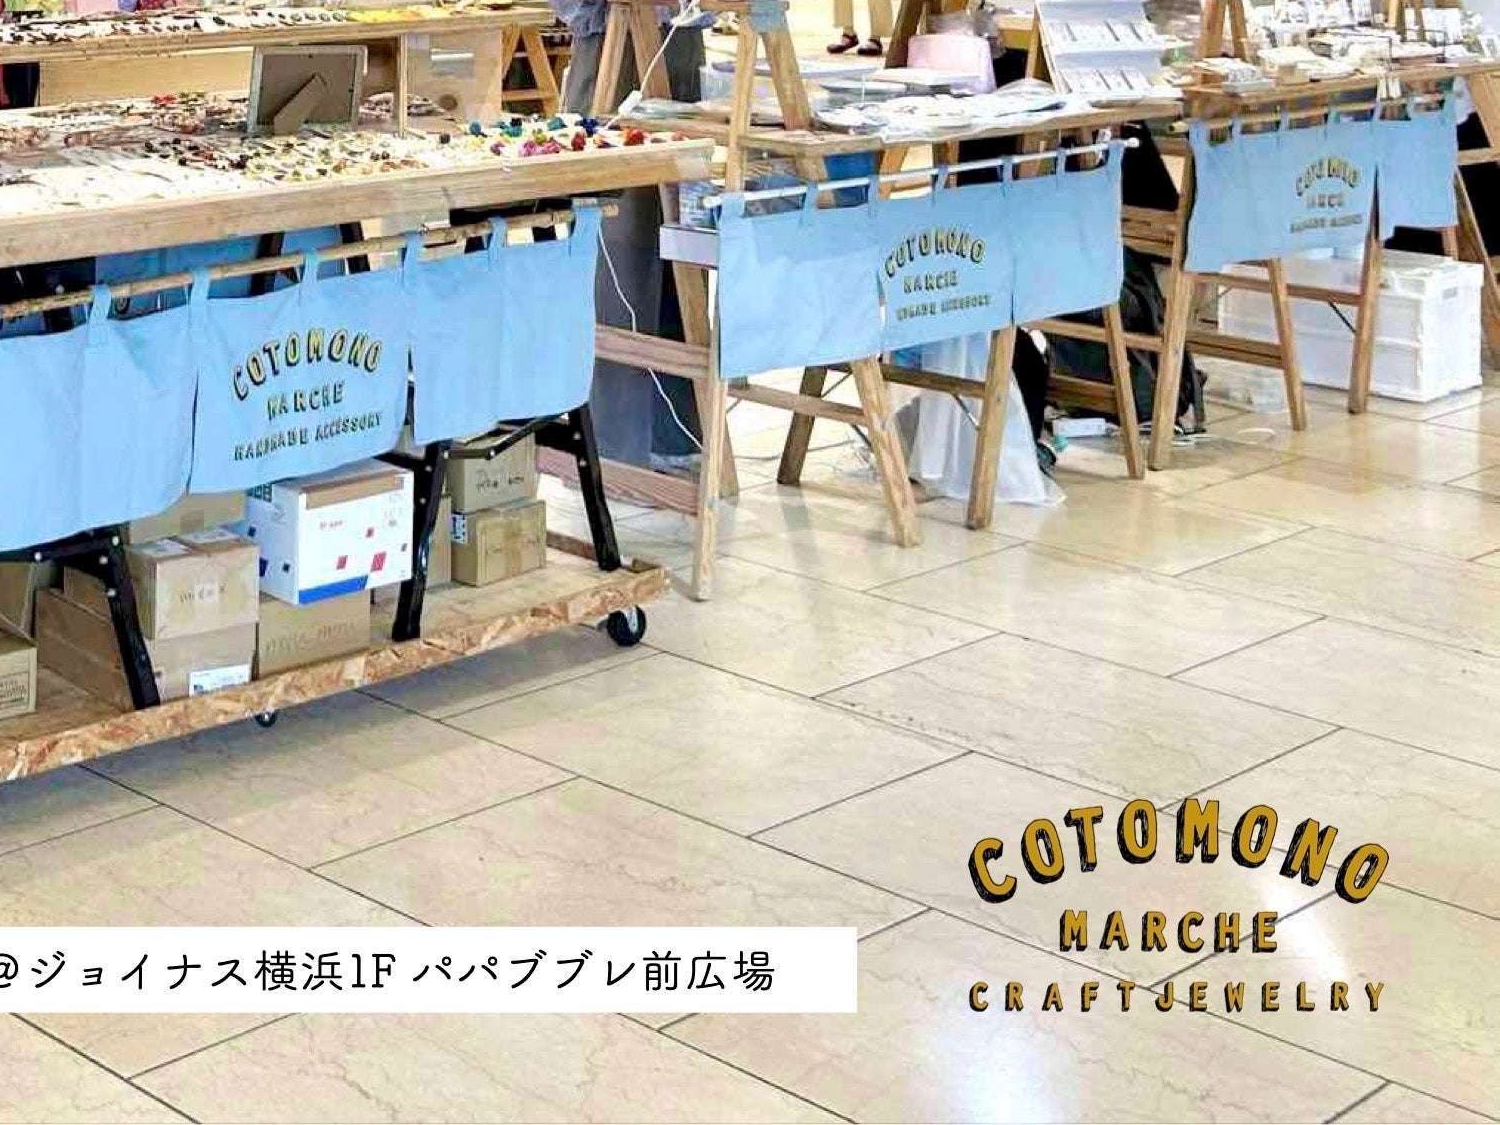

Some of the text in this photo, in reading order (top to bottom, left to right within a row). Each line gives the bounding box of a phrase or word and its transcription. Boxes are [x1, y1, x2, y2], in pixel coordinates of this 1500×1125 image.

[885, 227, 985, 277] COTOMONO
[233, 328, 382, 401] COTOMONO
[267, 380, 345, 421] MARCHE
[315, 412, 382, 441] ACCESSORY
